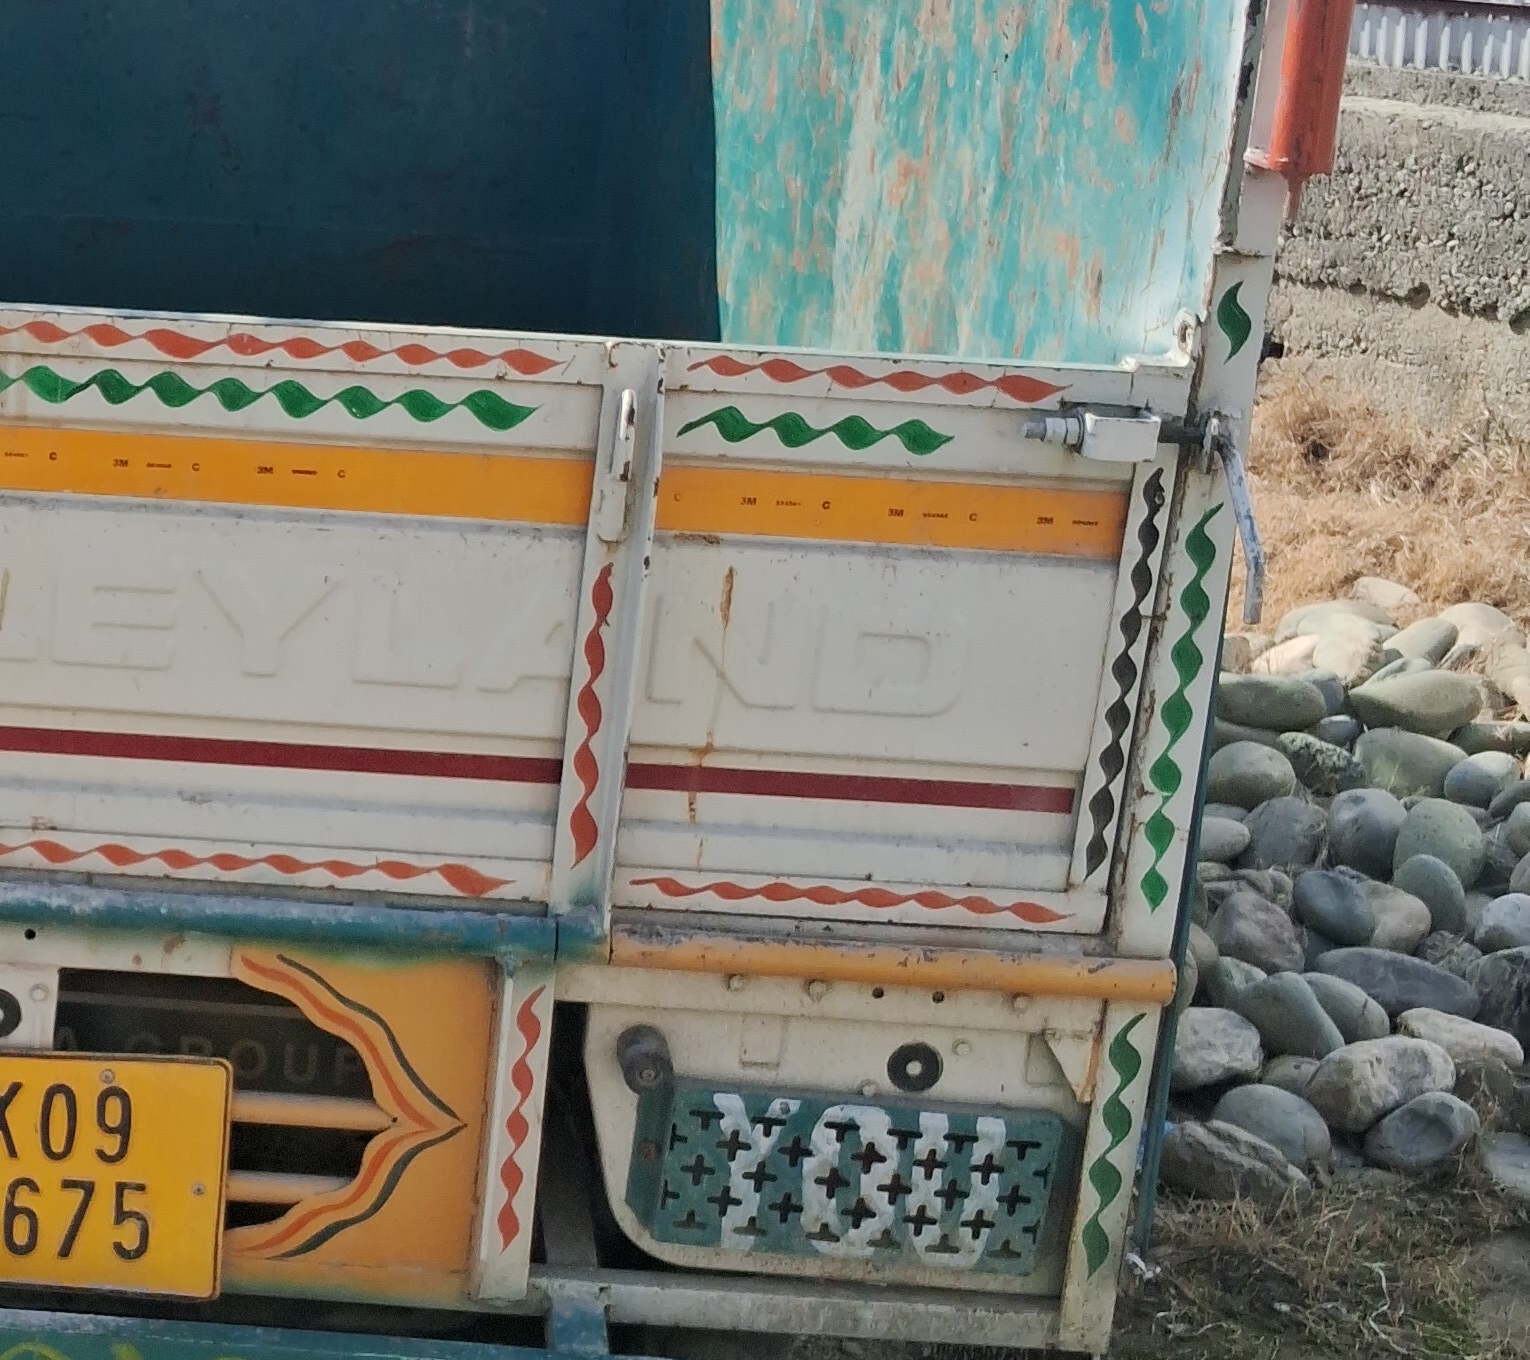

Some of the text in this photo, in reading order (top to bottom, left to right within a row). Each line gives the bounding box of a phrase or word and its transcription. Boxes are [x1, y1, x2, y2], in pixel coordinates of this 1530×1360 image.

[112, 458, 129, 468] 3M
[256, 465, 274, 475] 3M
[740, 496, 758, 506] 3M
[887, 508, 905, 518] 3M
[713, 1092, 1007, 1270] YOU
